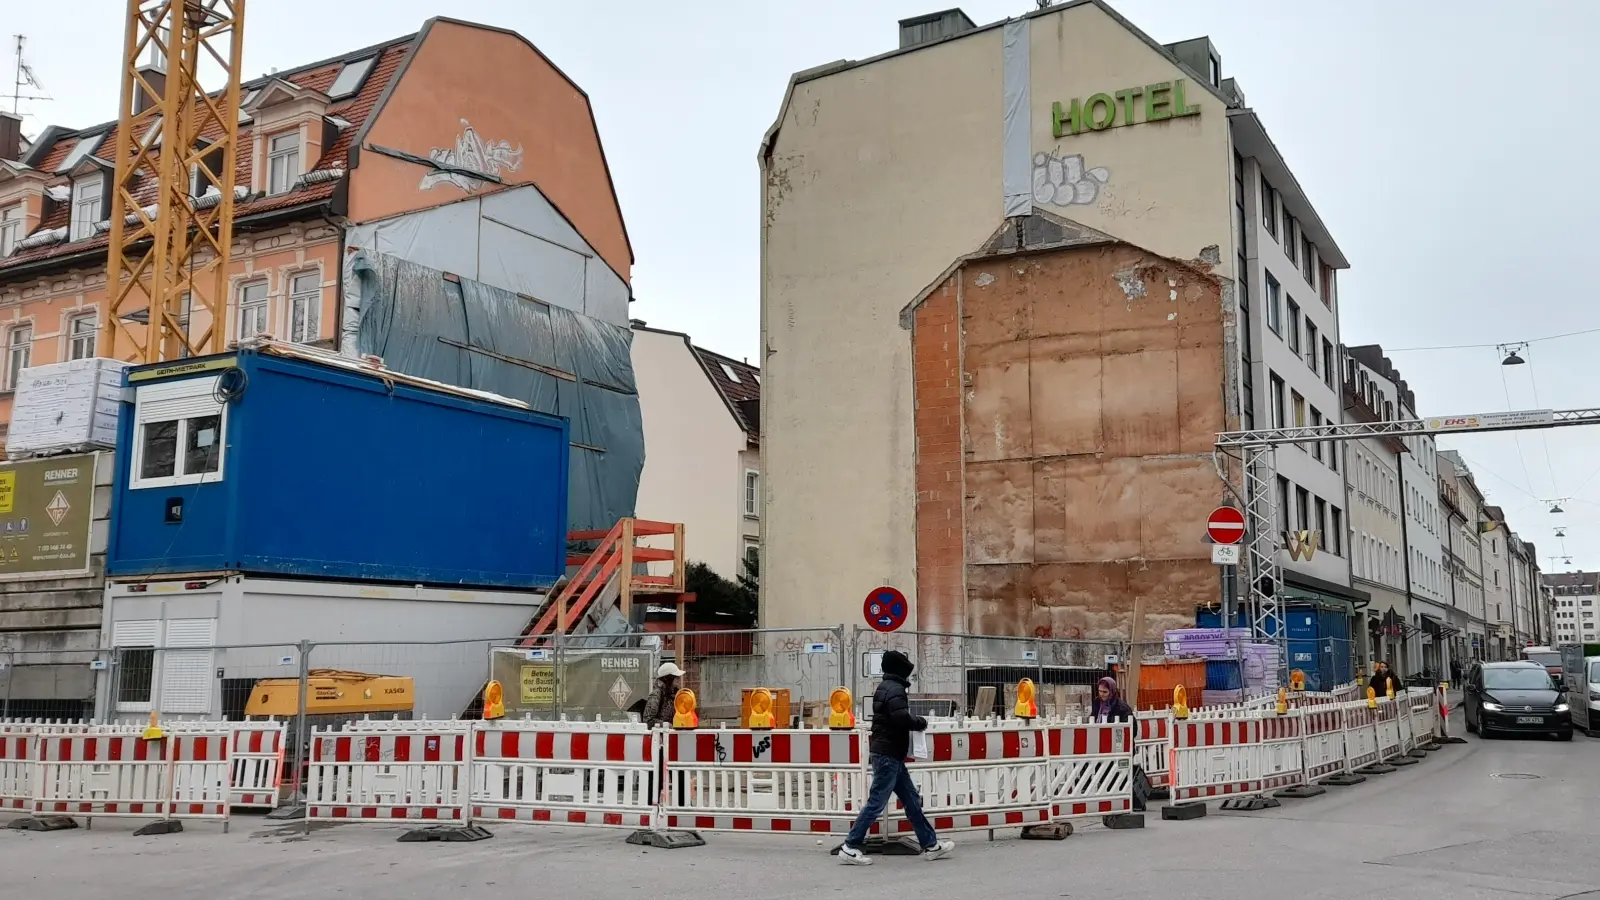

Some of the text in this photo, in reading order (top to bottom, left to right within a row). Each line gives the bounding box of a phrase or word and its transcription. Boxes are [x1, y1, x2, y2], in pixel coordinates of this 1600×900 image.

[1052, 79, 1201, 138] HOTEL
[1444, 418, 1466, 426] EHS
[44, 468, 78, 481] RENNER
[601, 658, 640, 668] RENNER
[531, 670, 555, 678] Betrete
